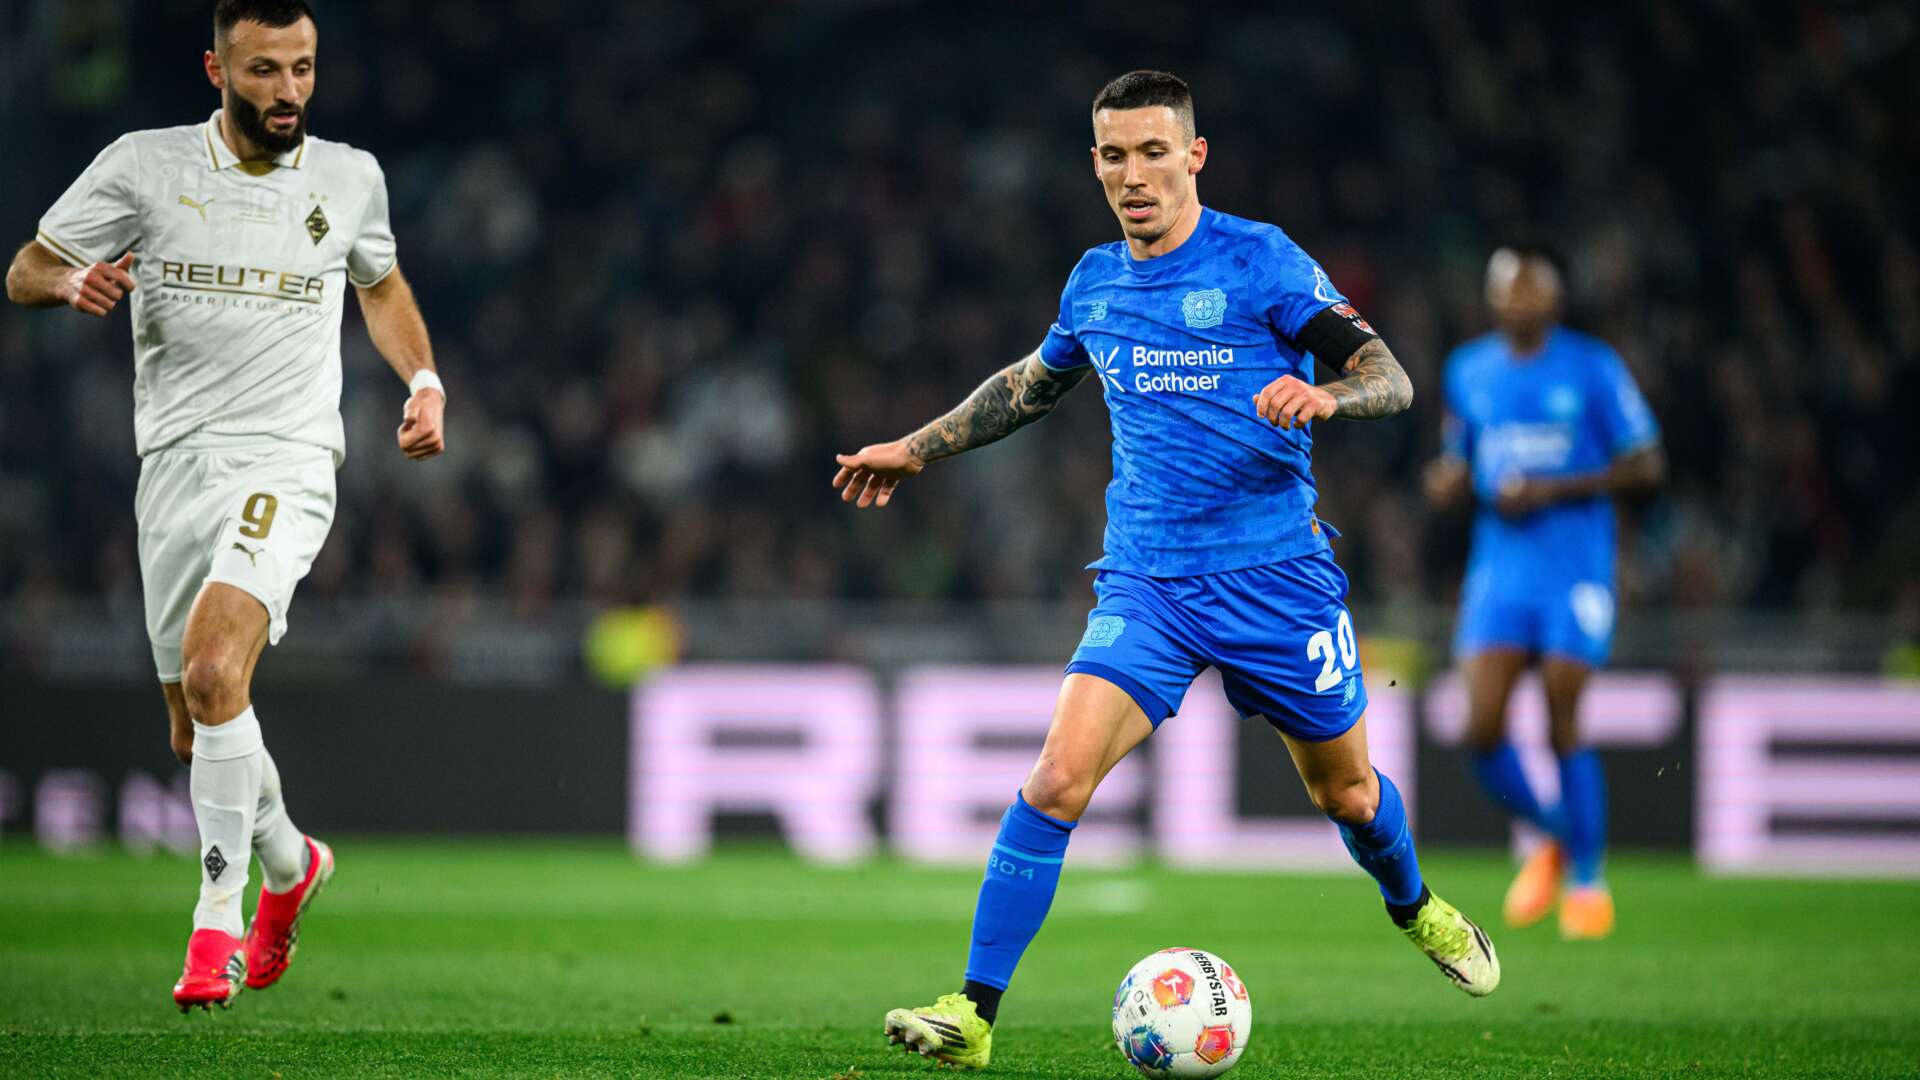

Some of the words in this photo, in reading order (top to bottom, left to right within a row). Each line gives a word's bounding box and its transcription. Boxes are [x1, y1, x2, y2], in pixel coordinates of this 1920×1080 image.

[163, 261, 325, 298] REUTER
[1133, 344, 1234, 367] Barmenia
[1135, 371, 1221, 393] Gothaer
[239, 492, 278, 539] 9
[1306, 610, 1357, 693] 20
[1190, 952, 1228, 1017] DERBYSTAR
